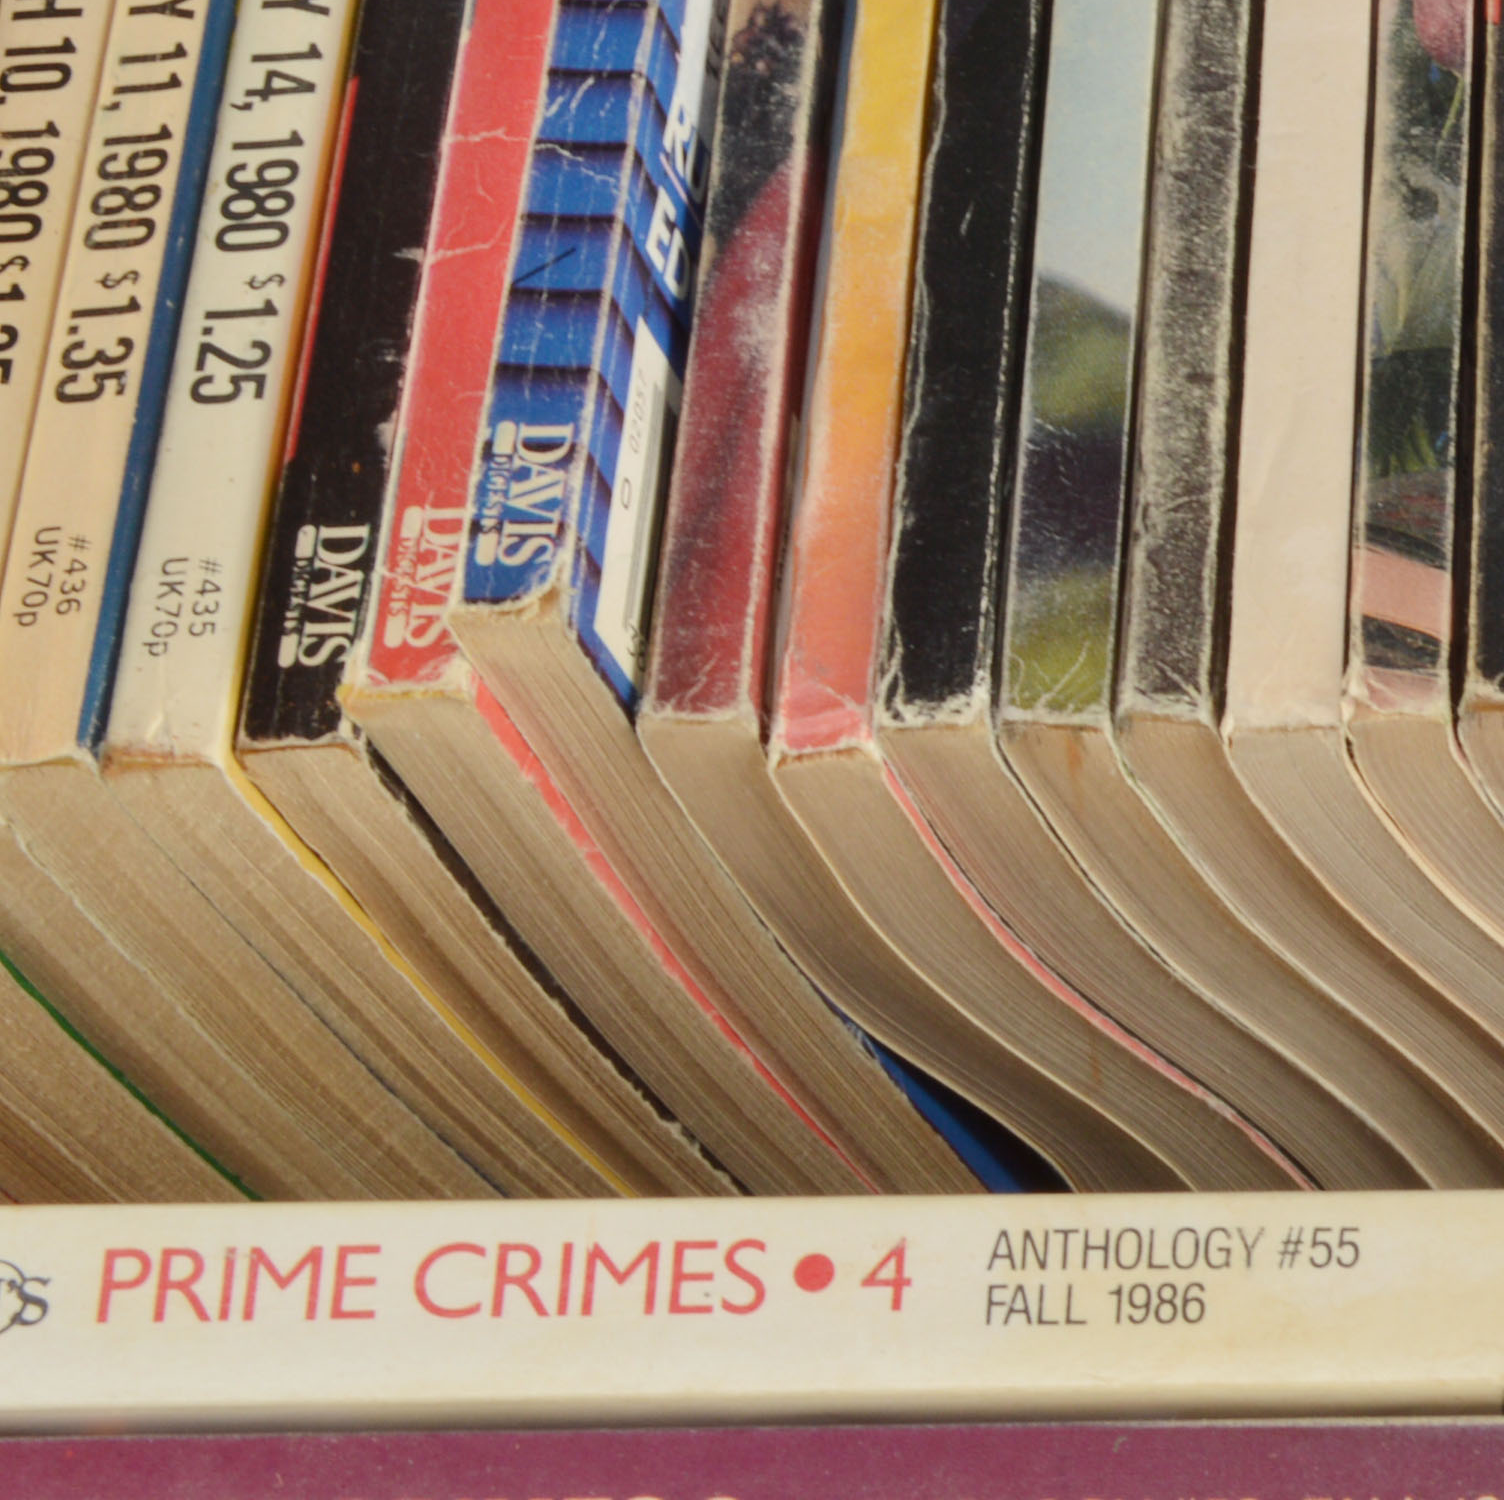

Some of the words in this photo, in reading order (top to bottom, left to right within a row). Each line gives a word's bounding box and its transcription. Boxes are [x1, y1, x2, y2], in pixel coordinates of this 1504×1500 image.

[103, 42, 187, 131] 11,
[230, 43, 322, 111] 14,
[84, 127, 171, 250] 1980
[215, 131, 302, 252] 1980
[54, 270, 140, 403] $1.35
[189, 274, 284, 404] $1.25
[498, 423, 573, 567] DAVIS
[14, 526, 61, 628] UK70p
[56, 533, 92, 616] #436
[143, 556, 189, 657] UK70p
[188, 557, 222, 637] #435
[298, 523, 370, 667] DAVIS
[406, 506, 466, 648] DAVIS
[97, 1245, 381, 1323] PRIME
[413, 1241, 767, 1318] CRIMES
[861, 1238, 912, 1311] 4
[986, 1228, 1265, 1271] ANTHOLOGY
[1277, 1226, 1361, 1269] #55
[985, 1284, 1087, 1326] FALL
[1107, 1283, 1206, 1325] 1986
